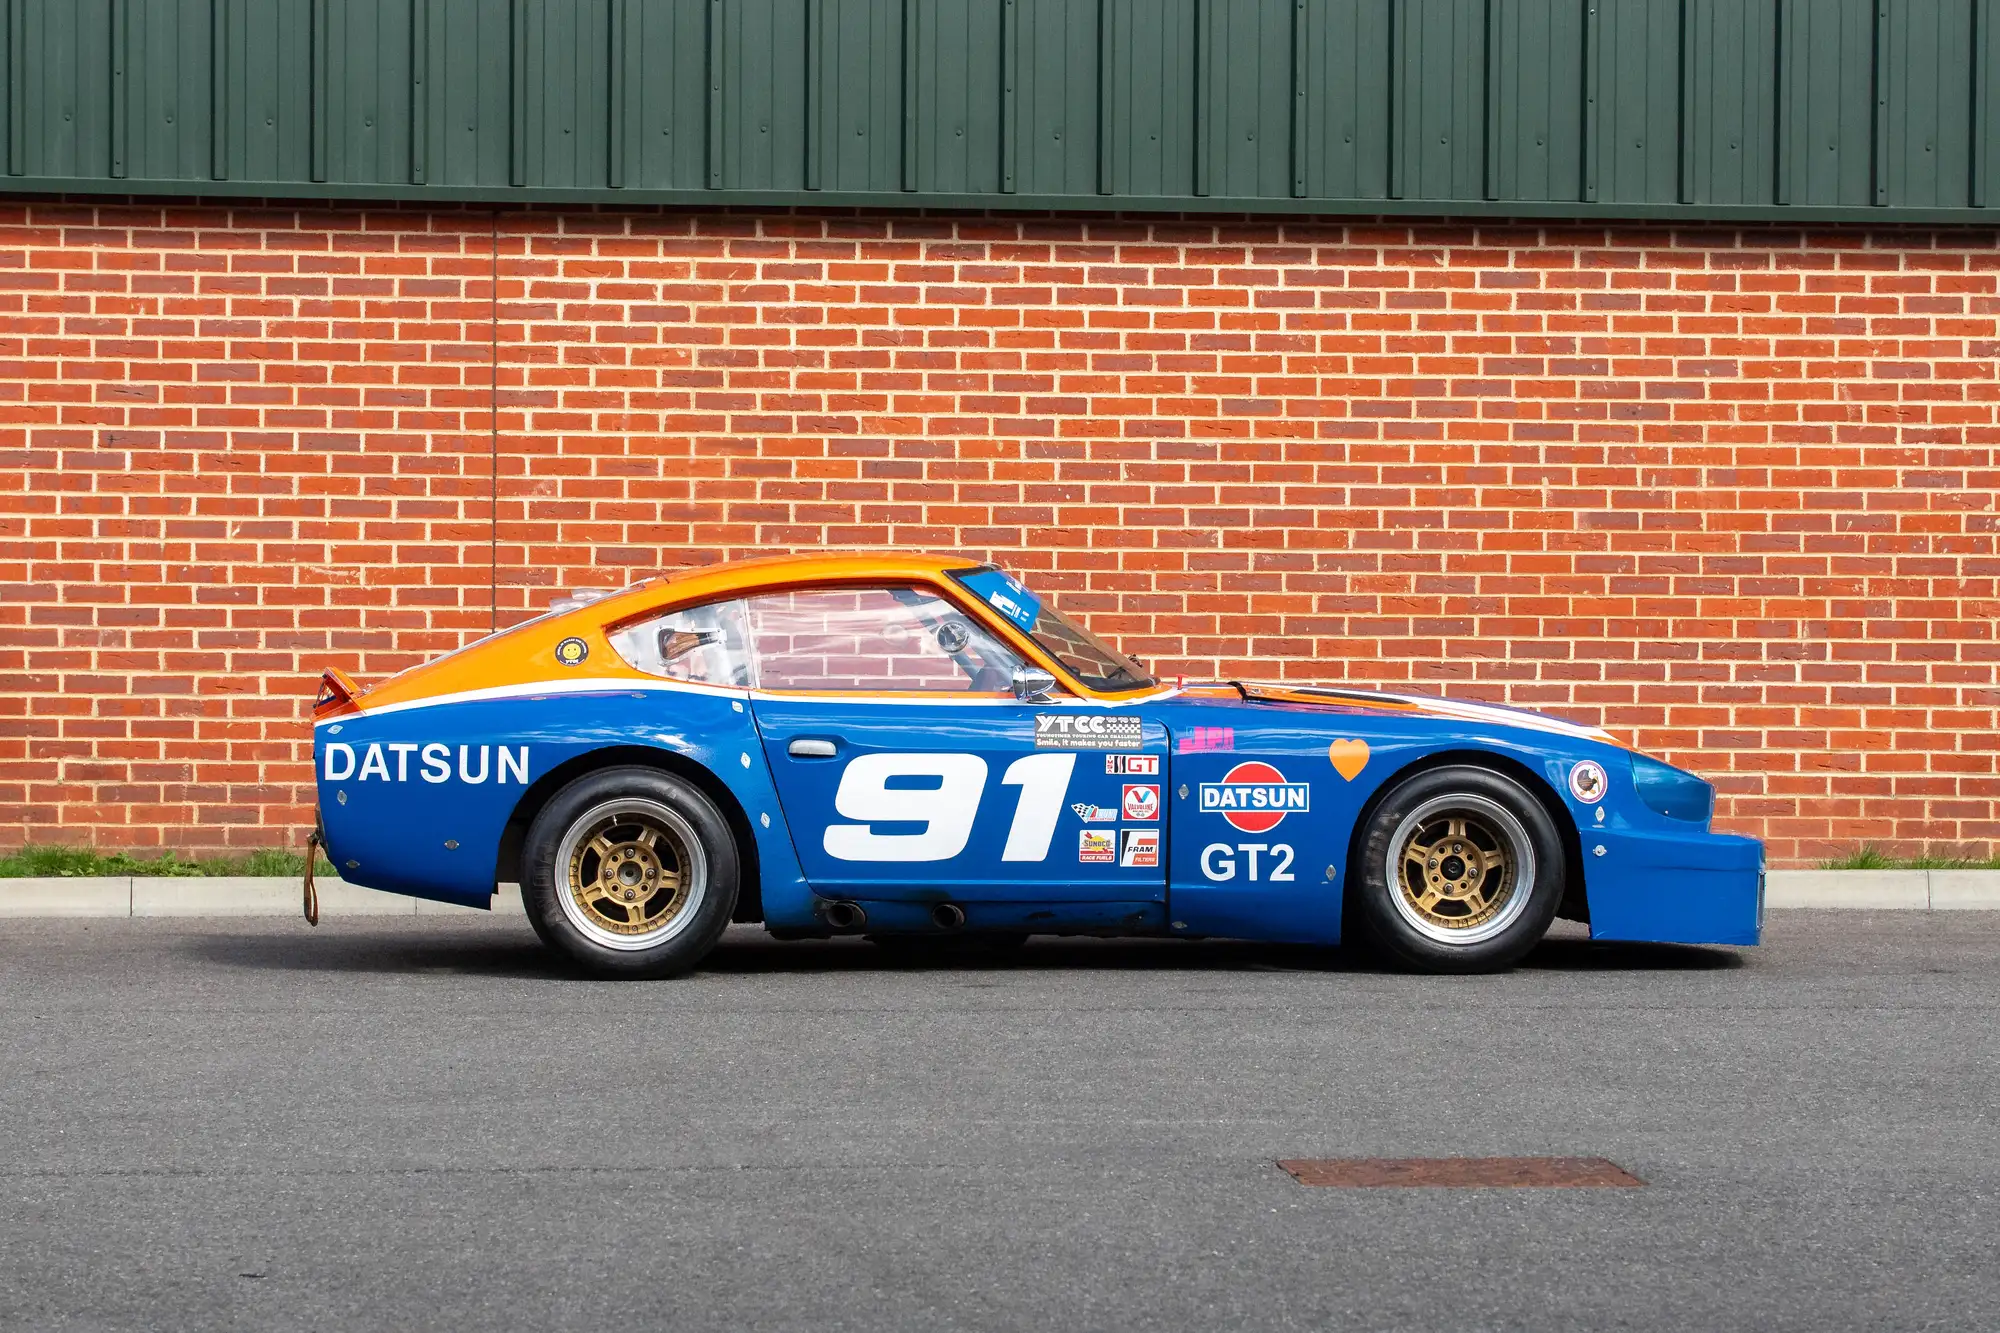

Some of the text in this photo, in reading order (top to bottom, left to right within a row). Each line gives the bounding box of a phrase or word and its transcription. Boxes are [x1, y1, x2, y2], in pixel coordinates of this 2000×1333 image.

[1036, 716, 1106, 734] YTCC
[1036, 739, 1060, 747] Smile,
[1098, 740, 1114, 748] you
[324, 742, 529, 785] DATSUN
[1128, 757, 1157, 772] GT
[1127, 803, 1154, 811] VALVOLINE
[1204, 787, 1305, 808] DATSUN
[823, 753, 1077, 862] 91
[1200, 843, 1295, 882] GT2
